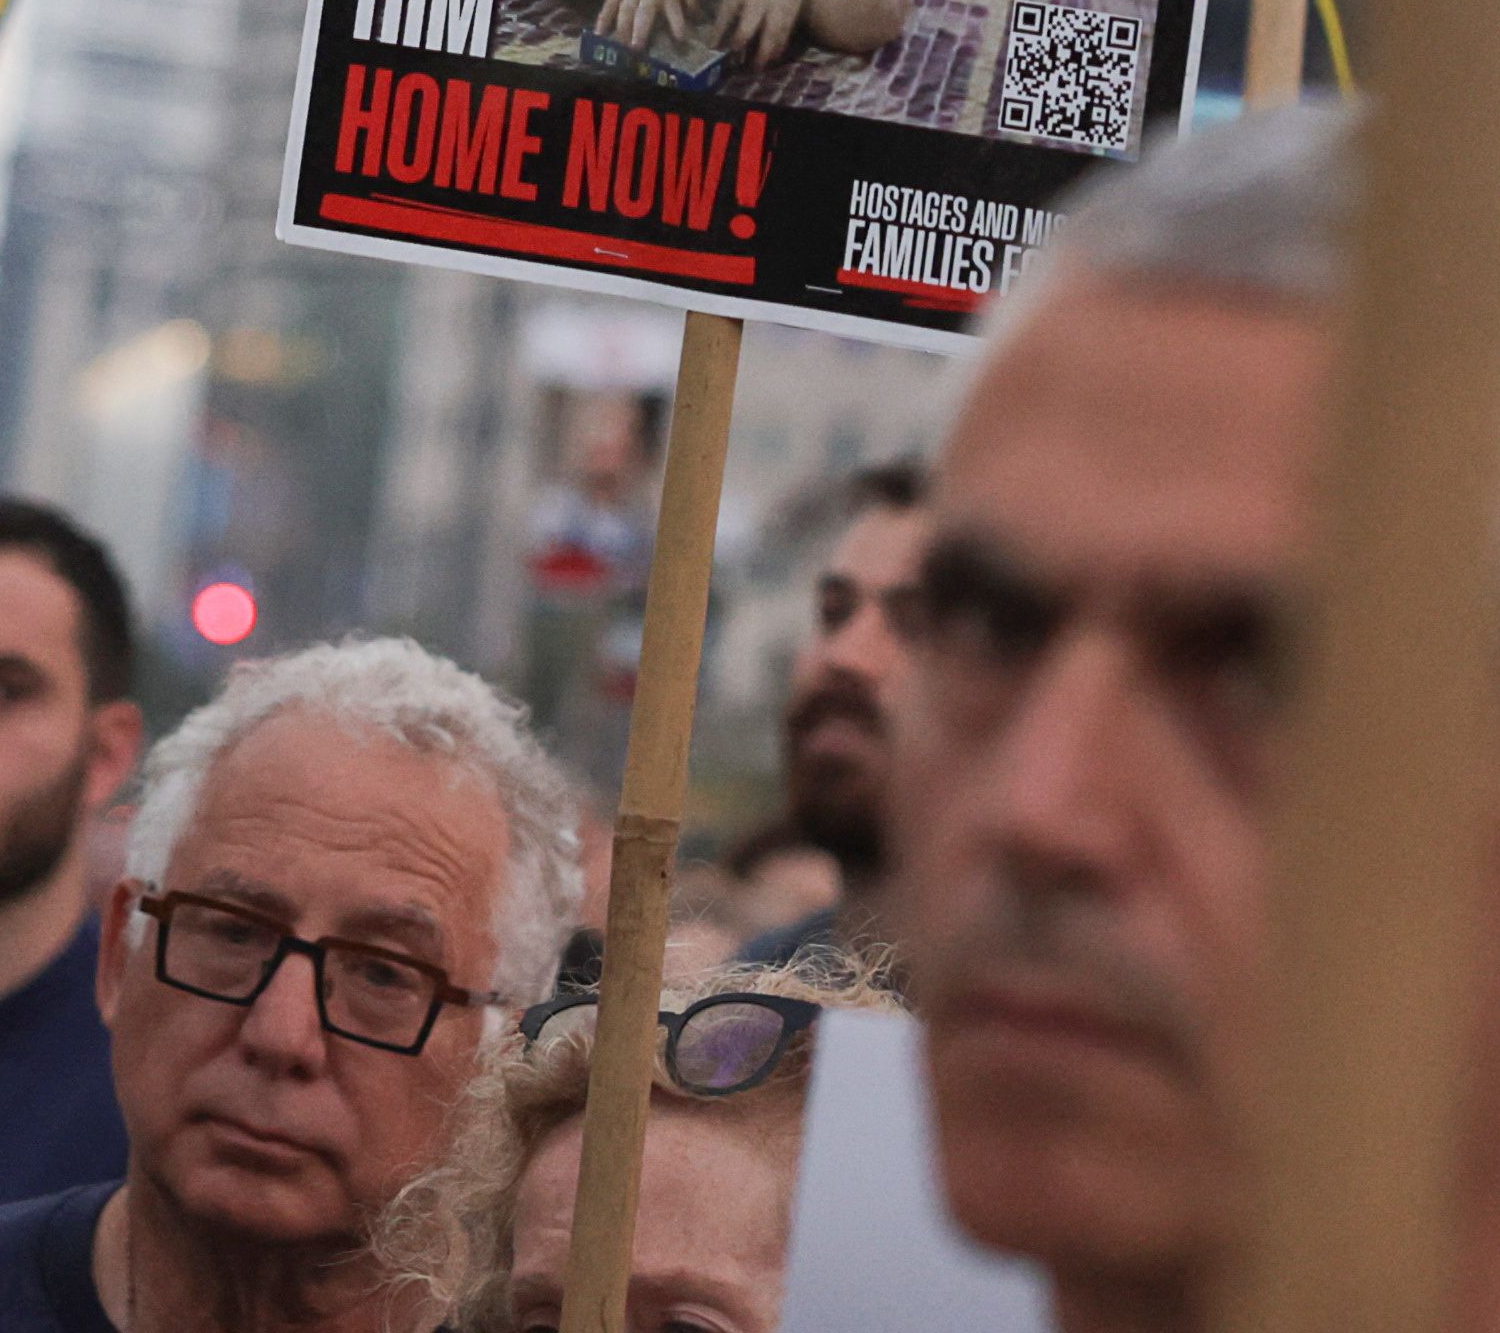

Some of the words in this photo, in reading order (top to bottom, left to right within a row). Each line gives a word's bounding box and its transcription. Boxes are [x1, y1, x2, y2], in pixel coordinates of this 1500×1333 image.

[334, 63, 550, 202] HOME
[562, 110, 768, 241] NOW!
[850, 179, 968, 234] HOSTAGES
[970, 199, 1018, 241] AND
[843, 218, 994, 294] FAMILIES
